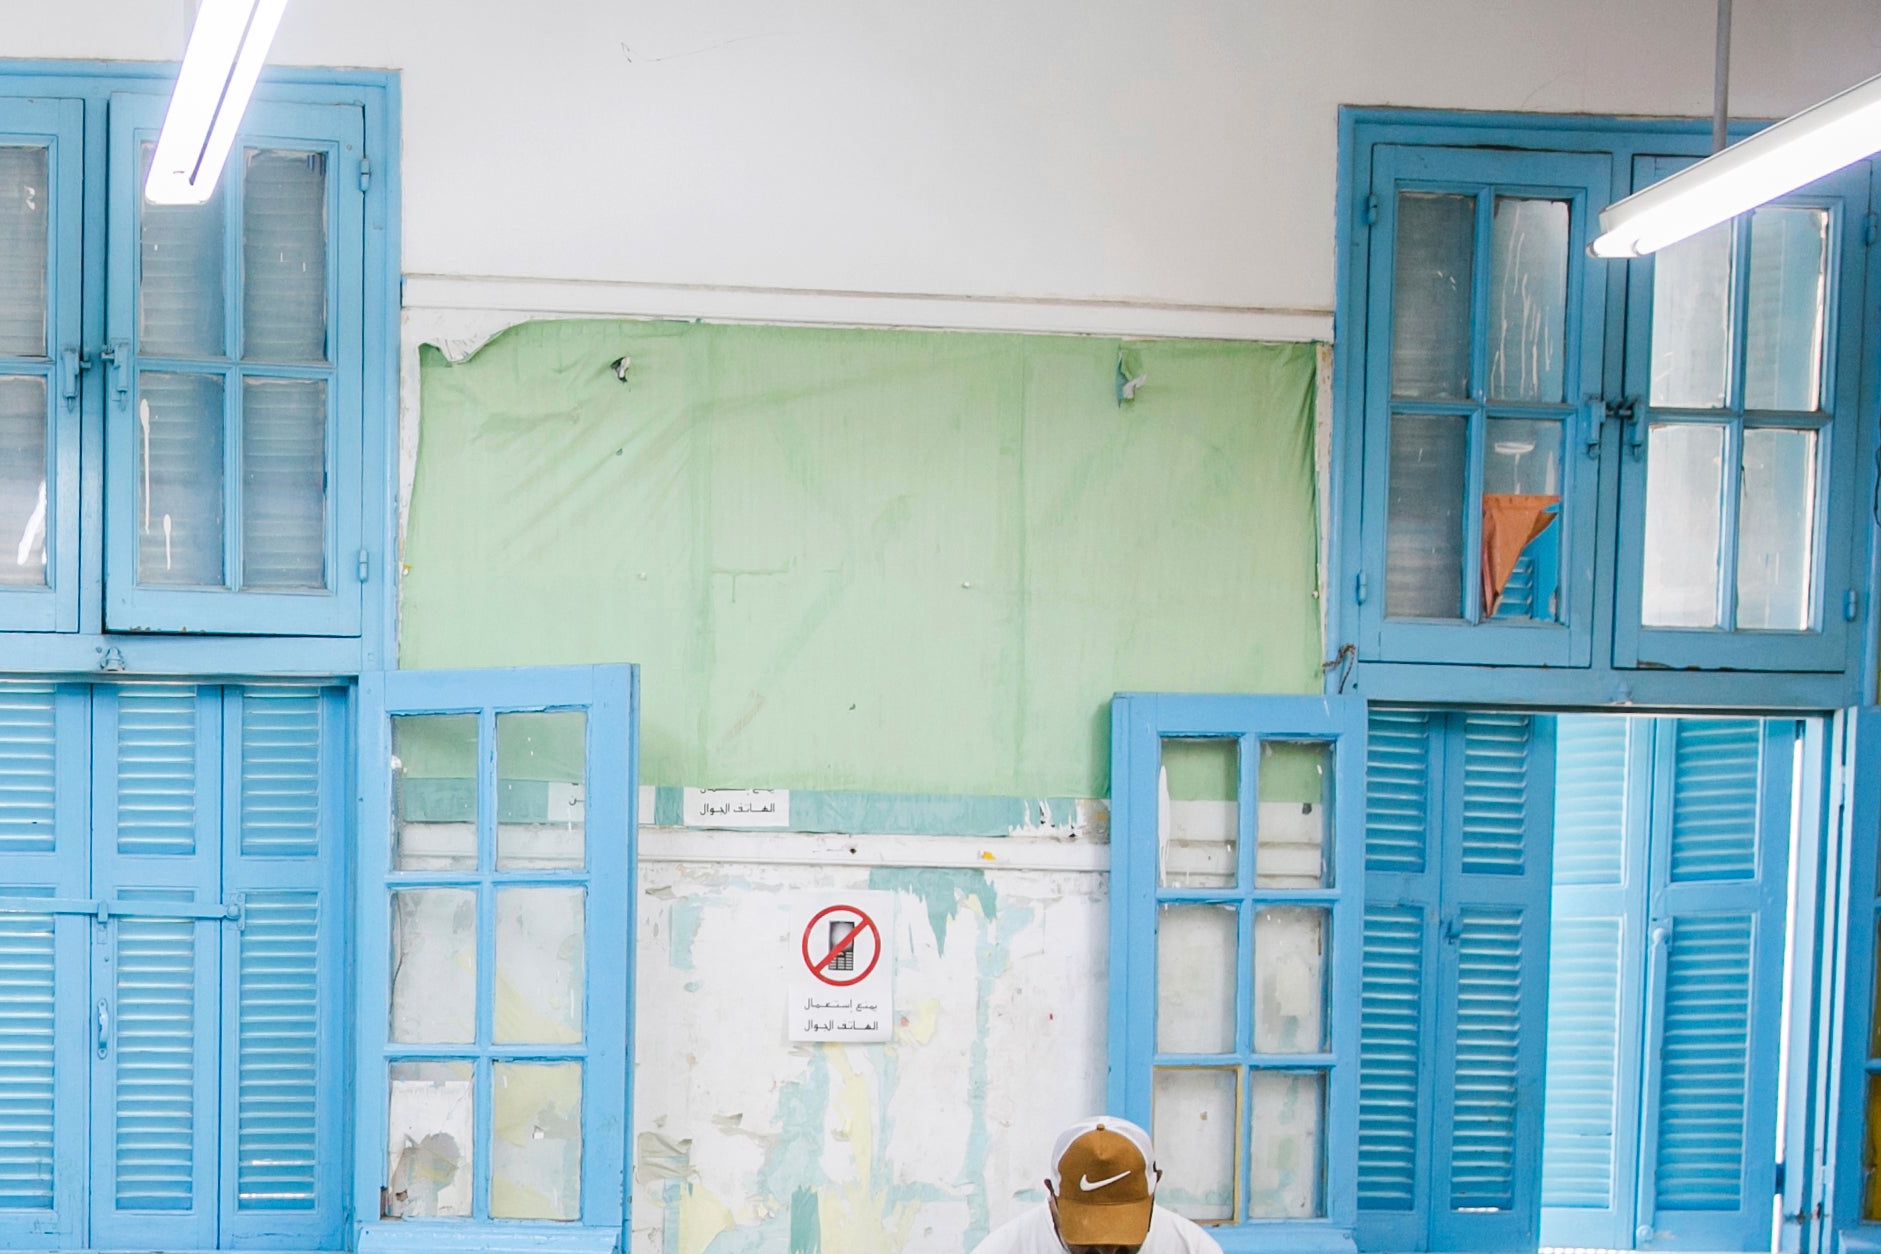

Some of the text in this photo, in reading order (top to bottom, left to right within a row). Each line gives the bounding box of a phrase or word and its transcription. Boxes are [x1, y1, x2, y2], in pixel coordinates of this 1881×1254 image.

[700, 802, 775, 816] الهاتف الجوال
[804, 1019, 878, 1032] الهاتف الجوال
